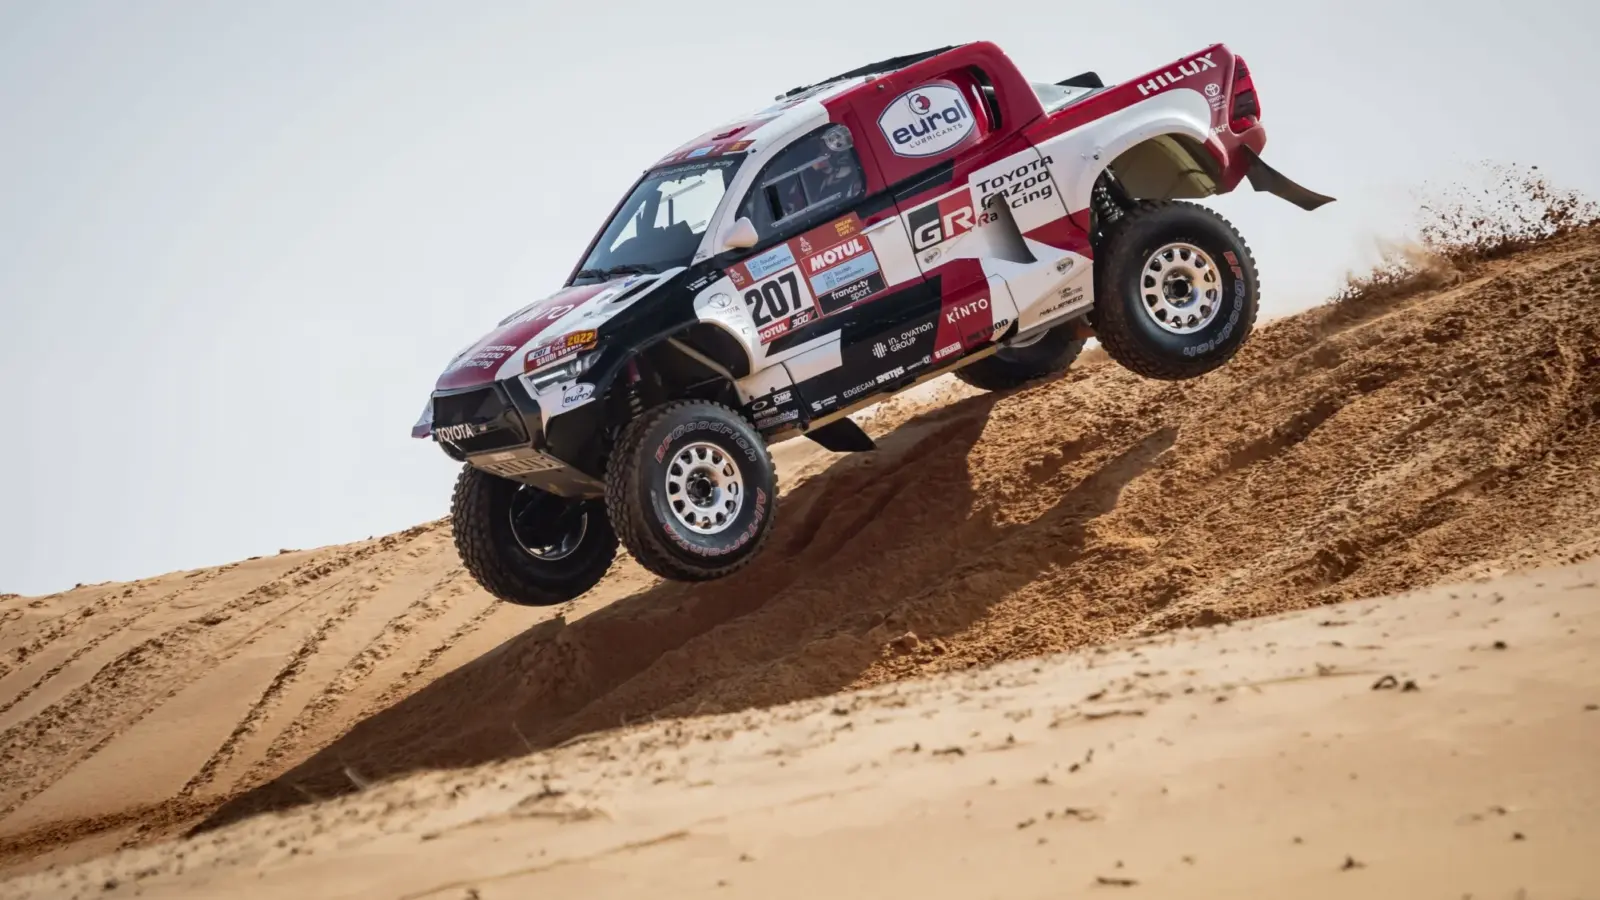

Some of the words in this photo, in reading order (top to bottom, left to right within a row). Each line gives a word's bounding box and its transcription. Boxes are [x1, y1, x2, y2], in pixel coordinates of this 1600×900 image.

[1137, 52, 1217, 96] HILUX
[892, 99, 968, 145] eurol
[909, 123, 963, 148] LUBRICANTS
[976, 155, 1053, 193] TOYOTA
[981, 170, 1050, 210] GAZOO
[810, 238, 864, 272] MOTUL
[744, 270, 801, 328] 207
[851, 286, 872, 302] sport
[1184, 251, 1245, 357] BFGoodrich
[567, 332, 594, 346] 2022
[890, 337, 917, 353] GROUP
[536, 353, 557, 366] SAUDI
[843, 379, 876, 399] EDGECAM
[436, 423, 475, 442] TOYOTA
[655, 421, 757, 464] BFGoodrich
